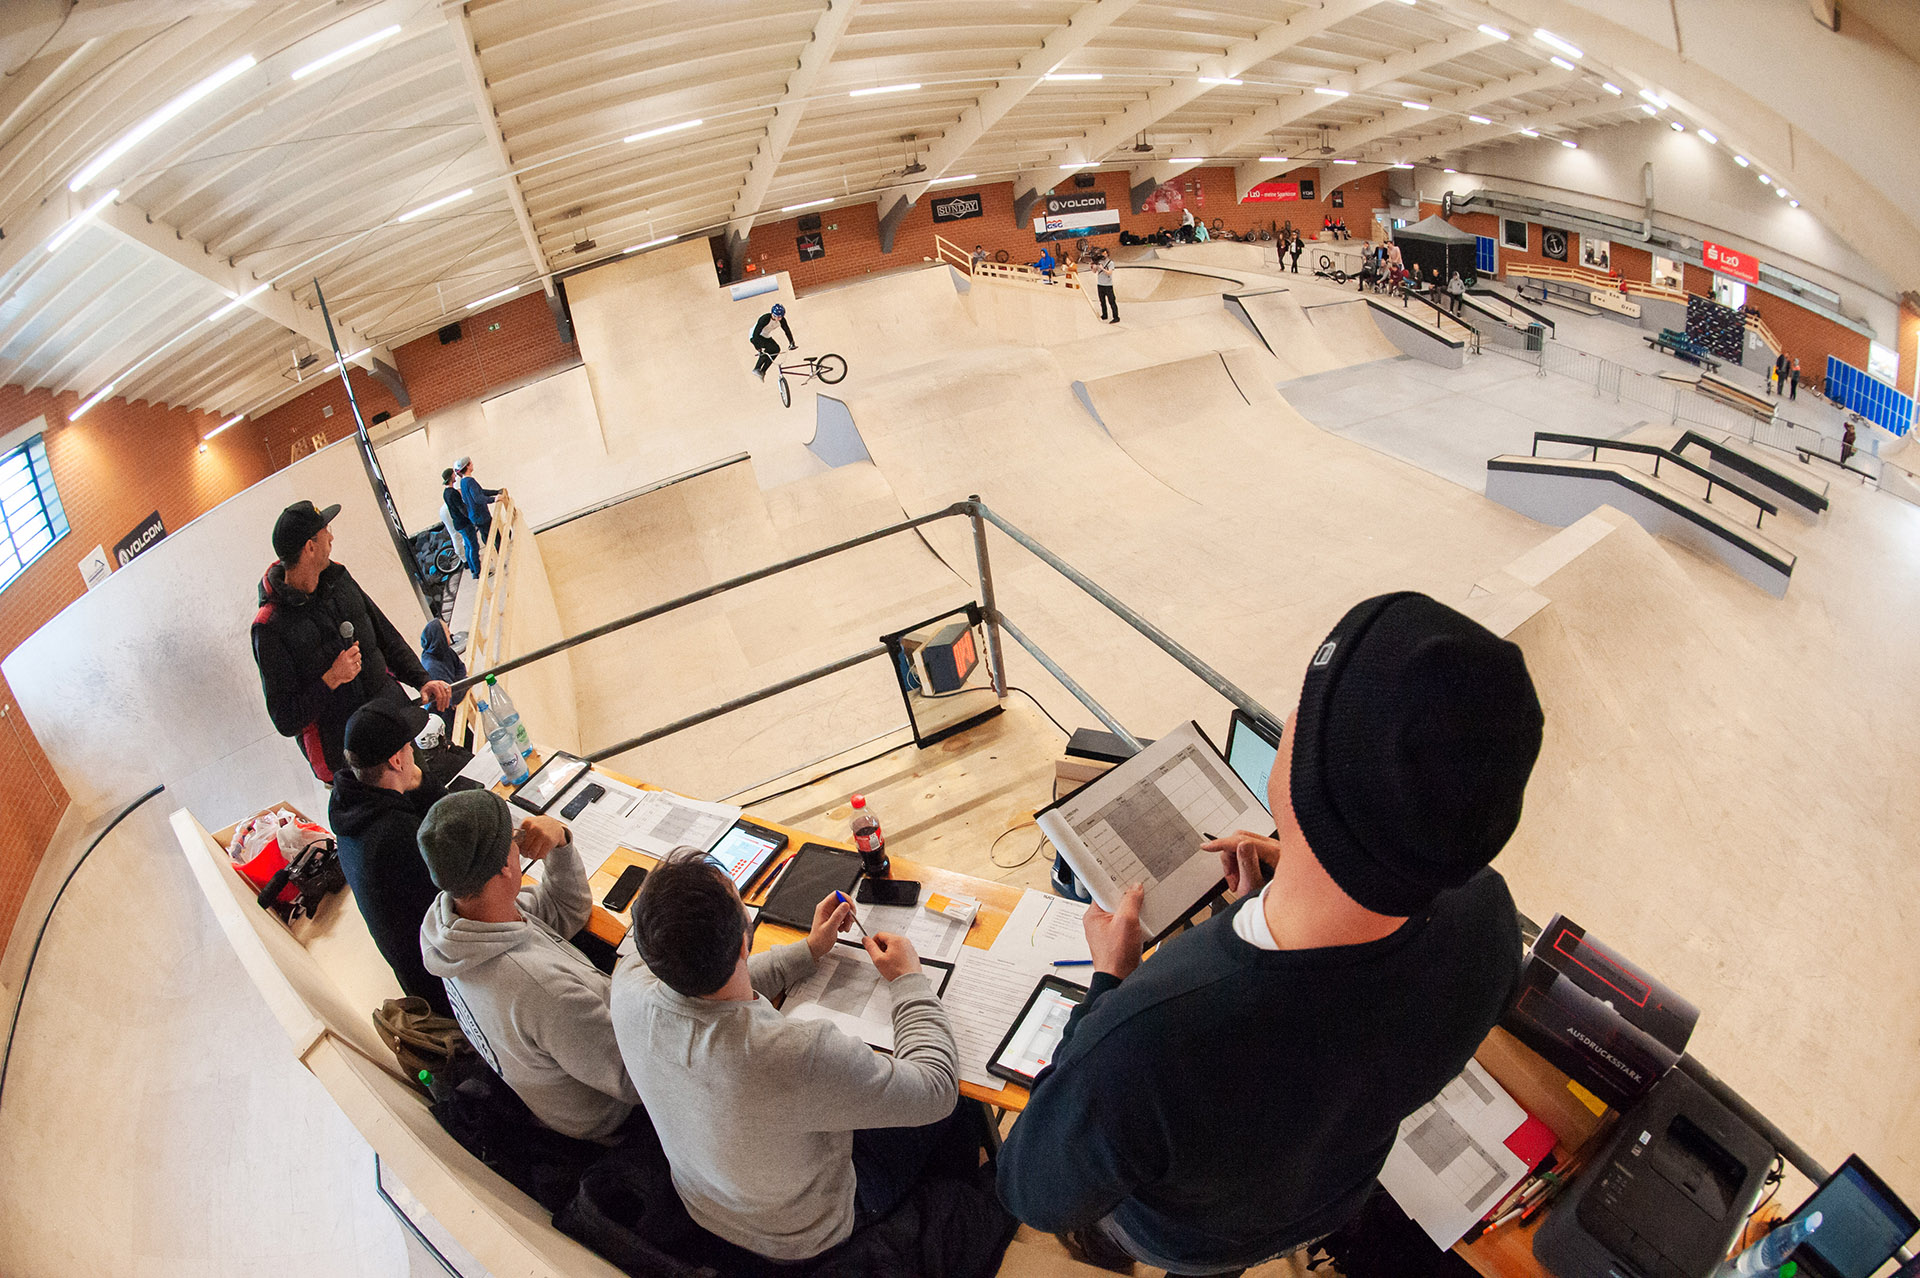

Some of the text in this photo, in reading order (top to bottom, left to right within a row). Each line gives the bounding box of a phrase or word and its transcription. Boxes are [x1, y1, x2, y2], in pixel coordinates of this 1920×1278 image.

[939, 201, 976, 215] SUNDAY
[1059, 197, 1105, 208] VOLCOM
[1720, 252, 1739, 268] LzO
[126, 520, 164, 558] VOLCOM
